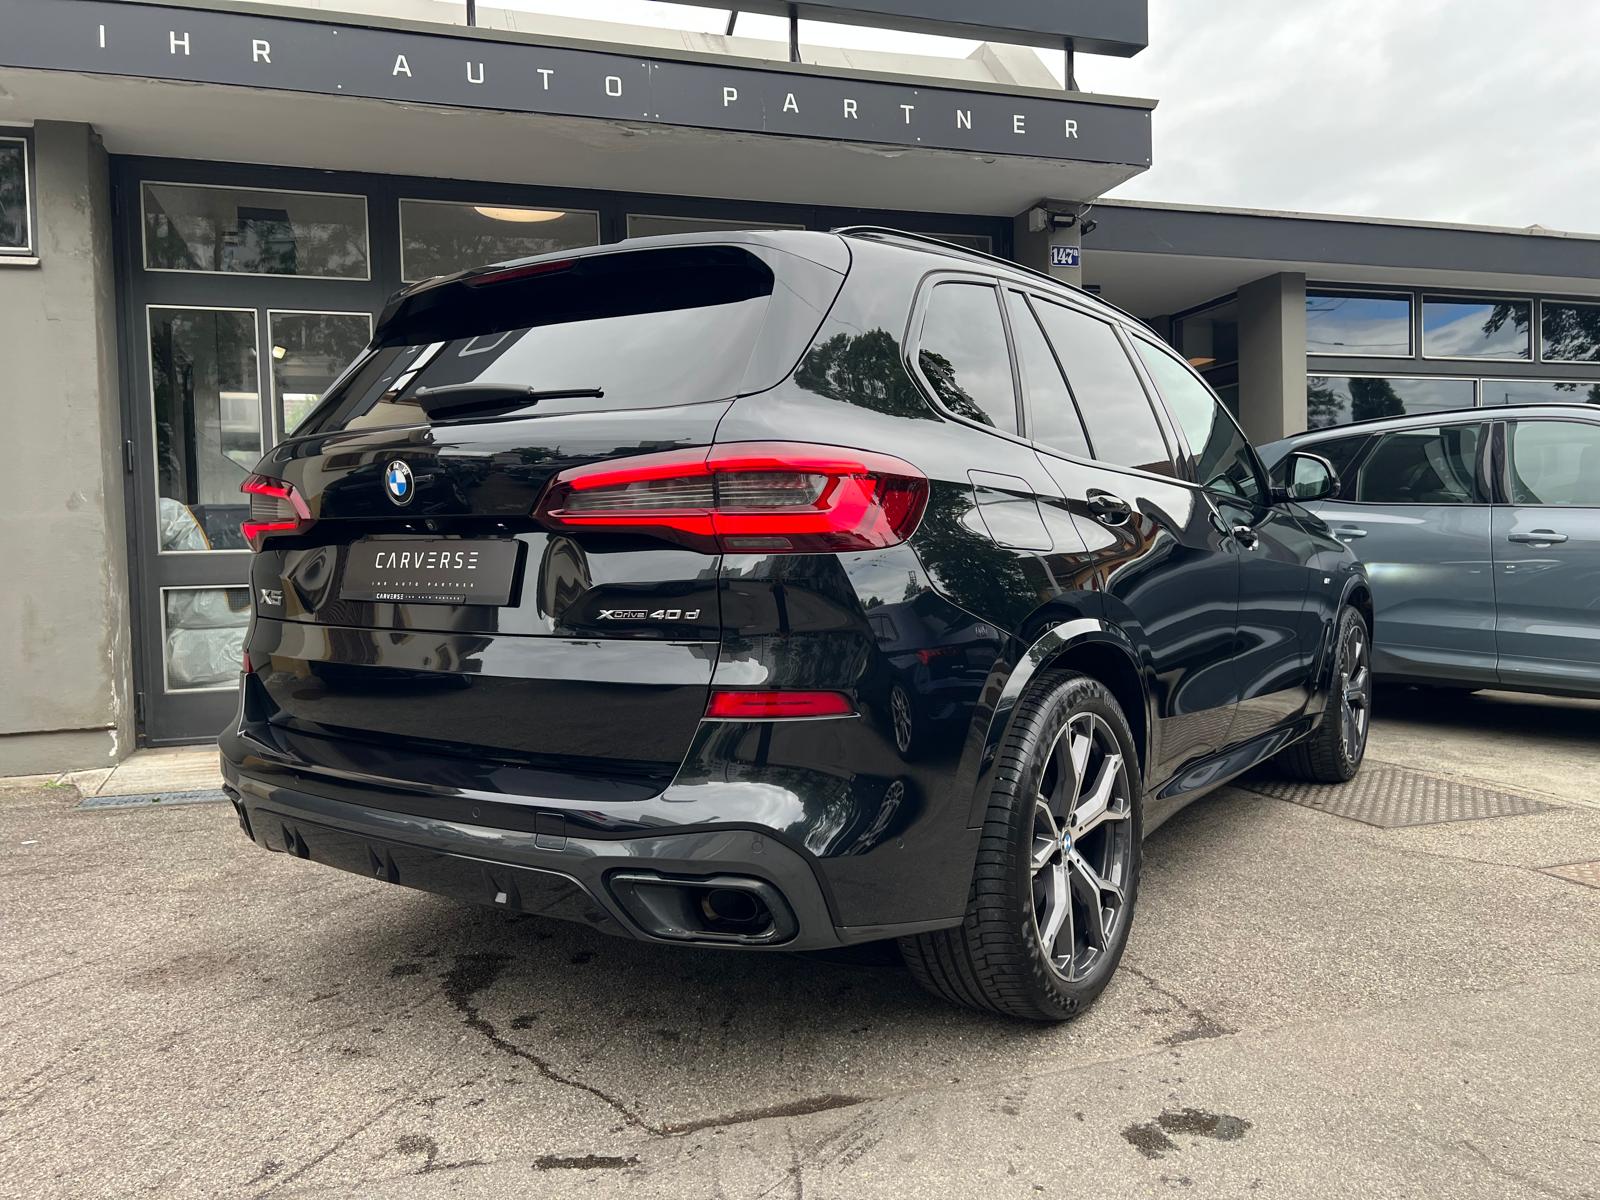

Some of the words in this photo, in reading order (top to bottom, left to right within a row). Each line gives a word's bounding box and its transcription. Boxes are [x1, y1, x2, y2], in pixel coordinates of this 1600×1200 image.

[99, 24, 272, 64] IHR
[392, 54, 623, 98] AUTO
[722, 86, 1079, 139] PARTNER
[375, 552, 479, 569] CARVERSE
[260, 588, 283, 606] X5
